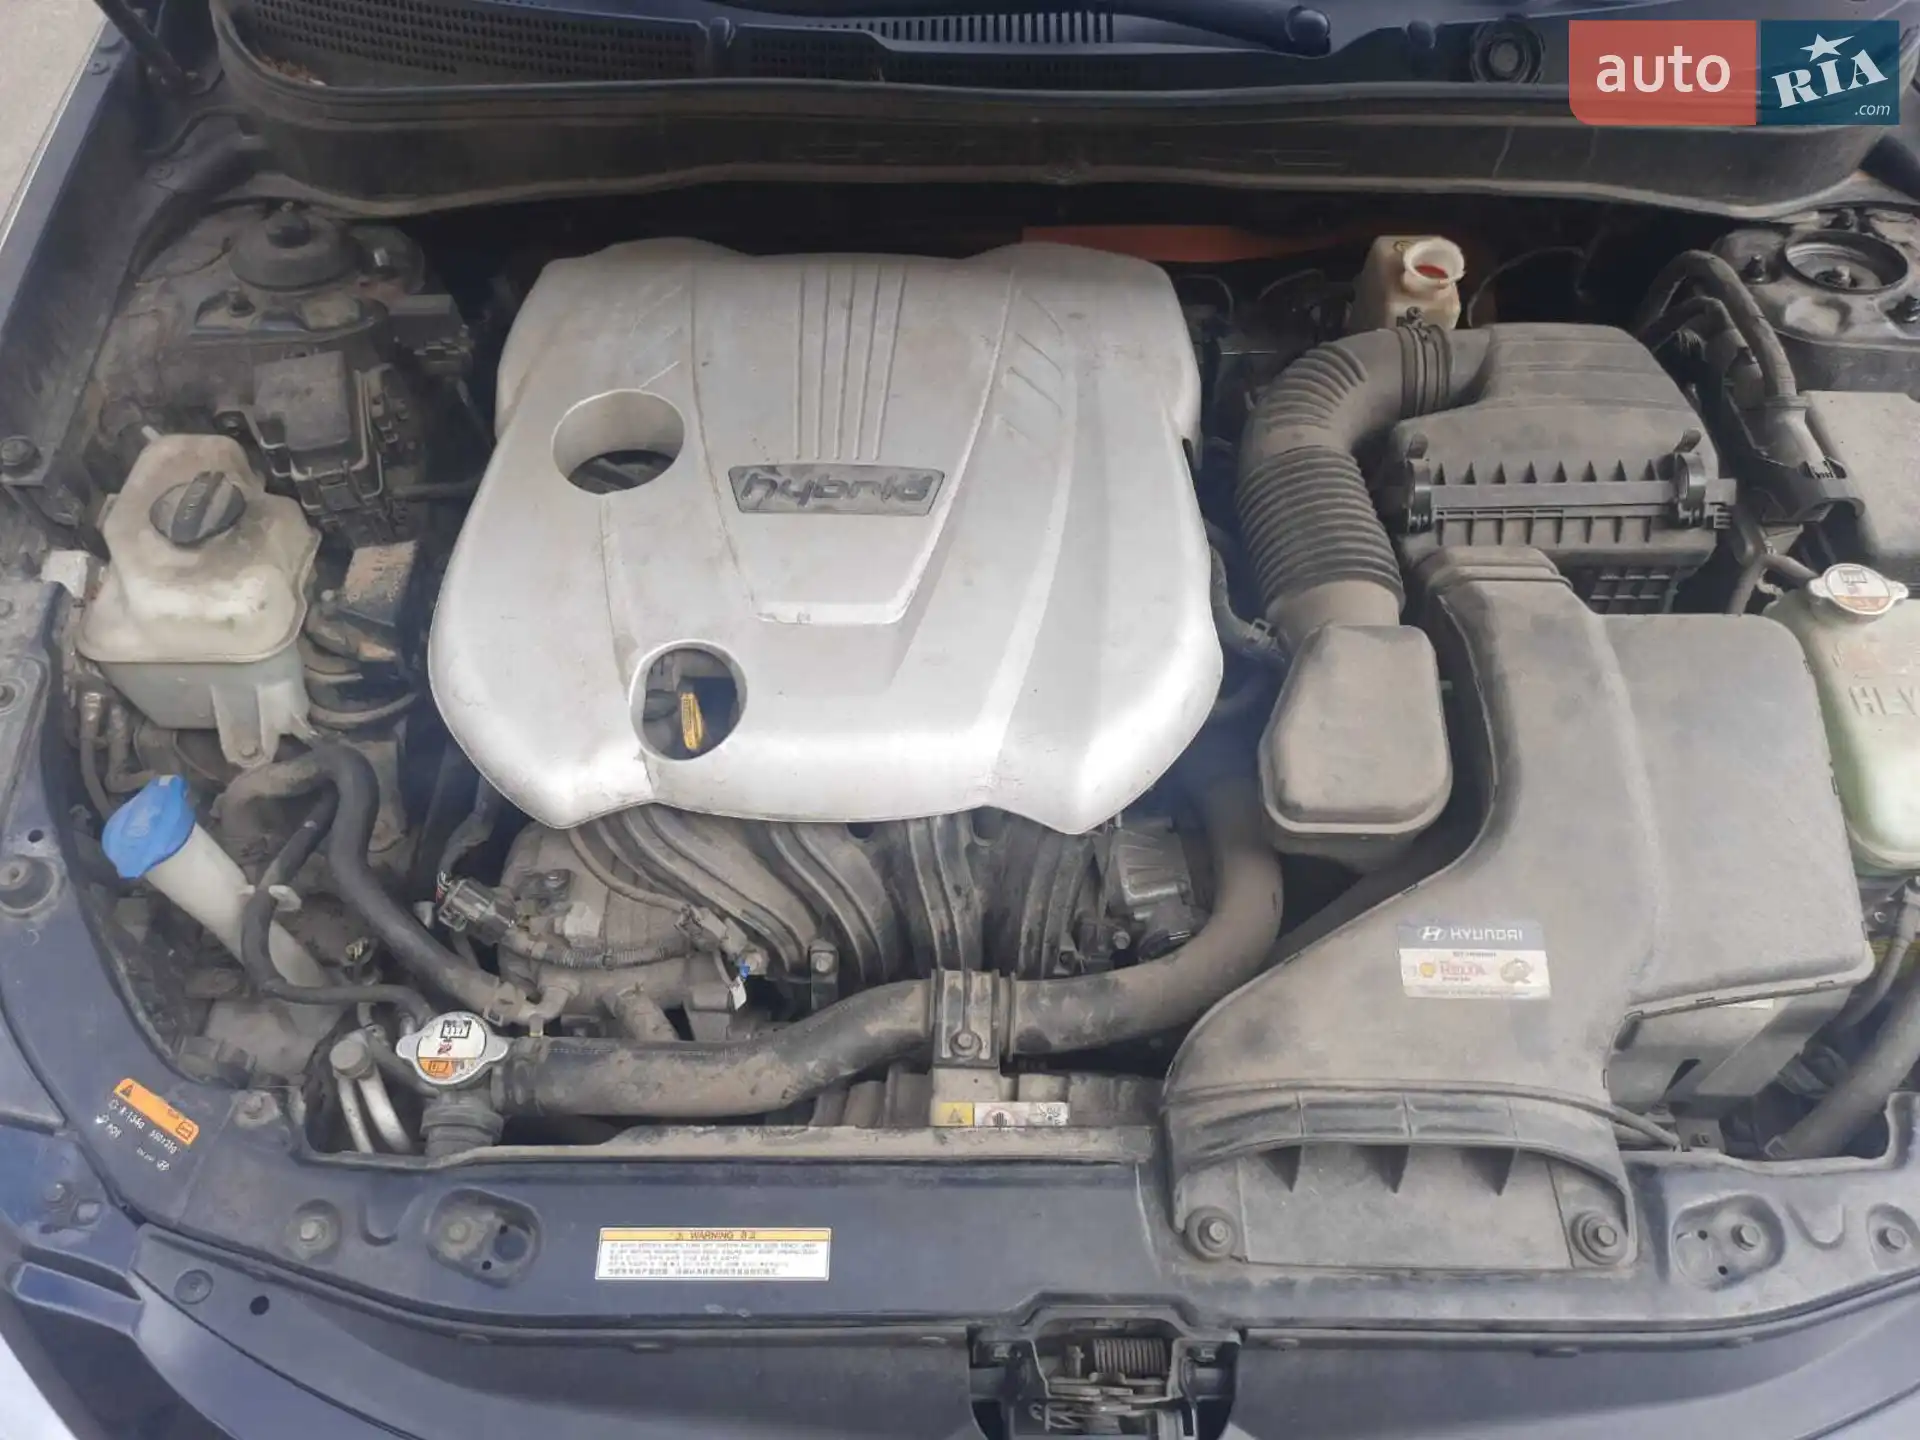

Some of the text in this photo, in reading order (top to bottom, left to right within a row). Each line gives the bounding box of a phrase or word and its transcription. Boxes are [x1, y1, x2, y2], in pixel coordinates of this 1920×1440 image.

[740, 473, 934, 507] hybrid
[1450, 928, 1524, 941] HYUNDAI
[690, 1229, 735, 1240] WARNING
